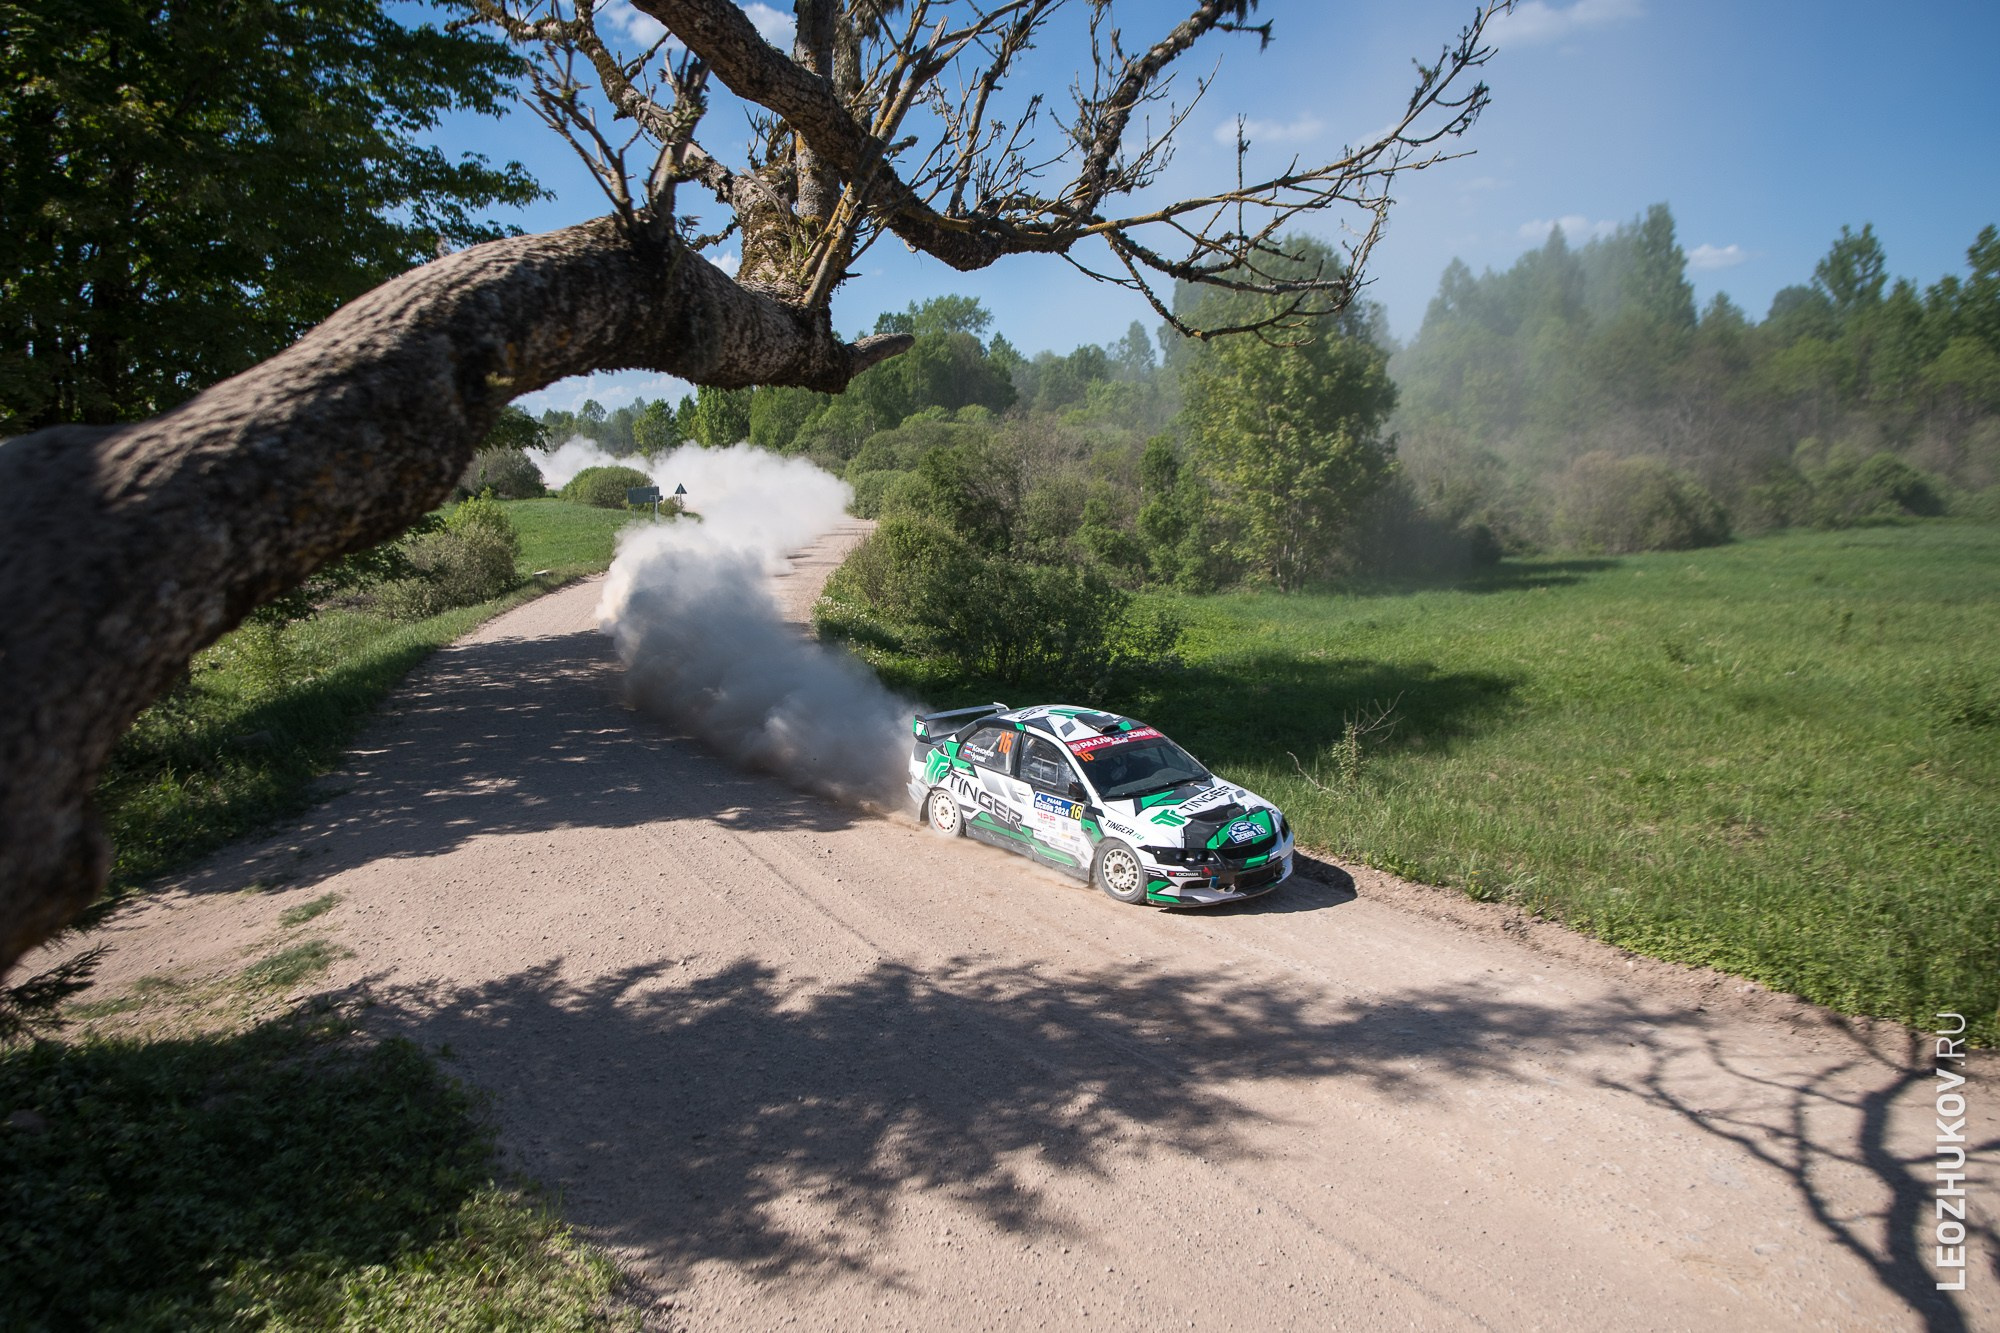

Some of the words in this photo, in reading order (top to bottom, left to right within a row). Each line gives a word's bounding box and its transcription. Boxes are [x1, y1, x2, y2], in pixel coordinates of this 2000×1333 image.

[998, 731, 1014, 754] 16
[1077, 751, 1094, 762] 16
[950, 771, 1022, 831] TINGER
[1179, 786, 1234, 811] TINGER
[1054, 806, 1070, 816] 2024
[1070, 804, 1082, 820] 16
[1253, 824, 1267, 835] 16
